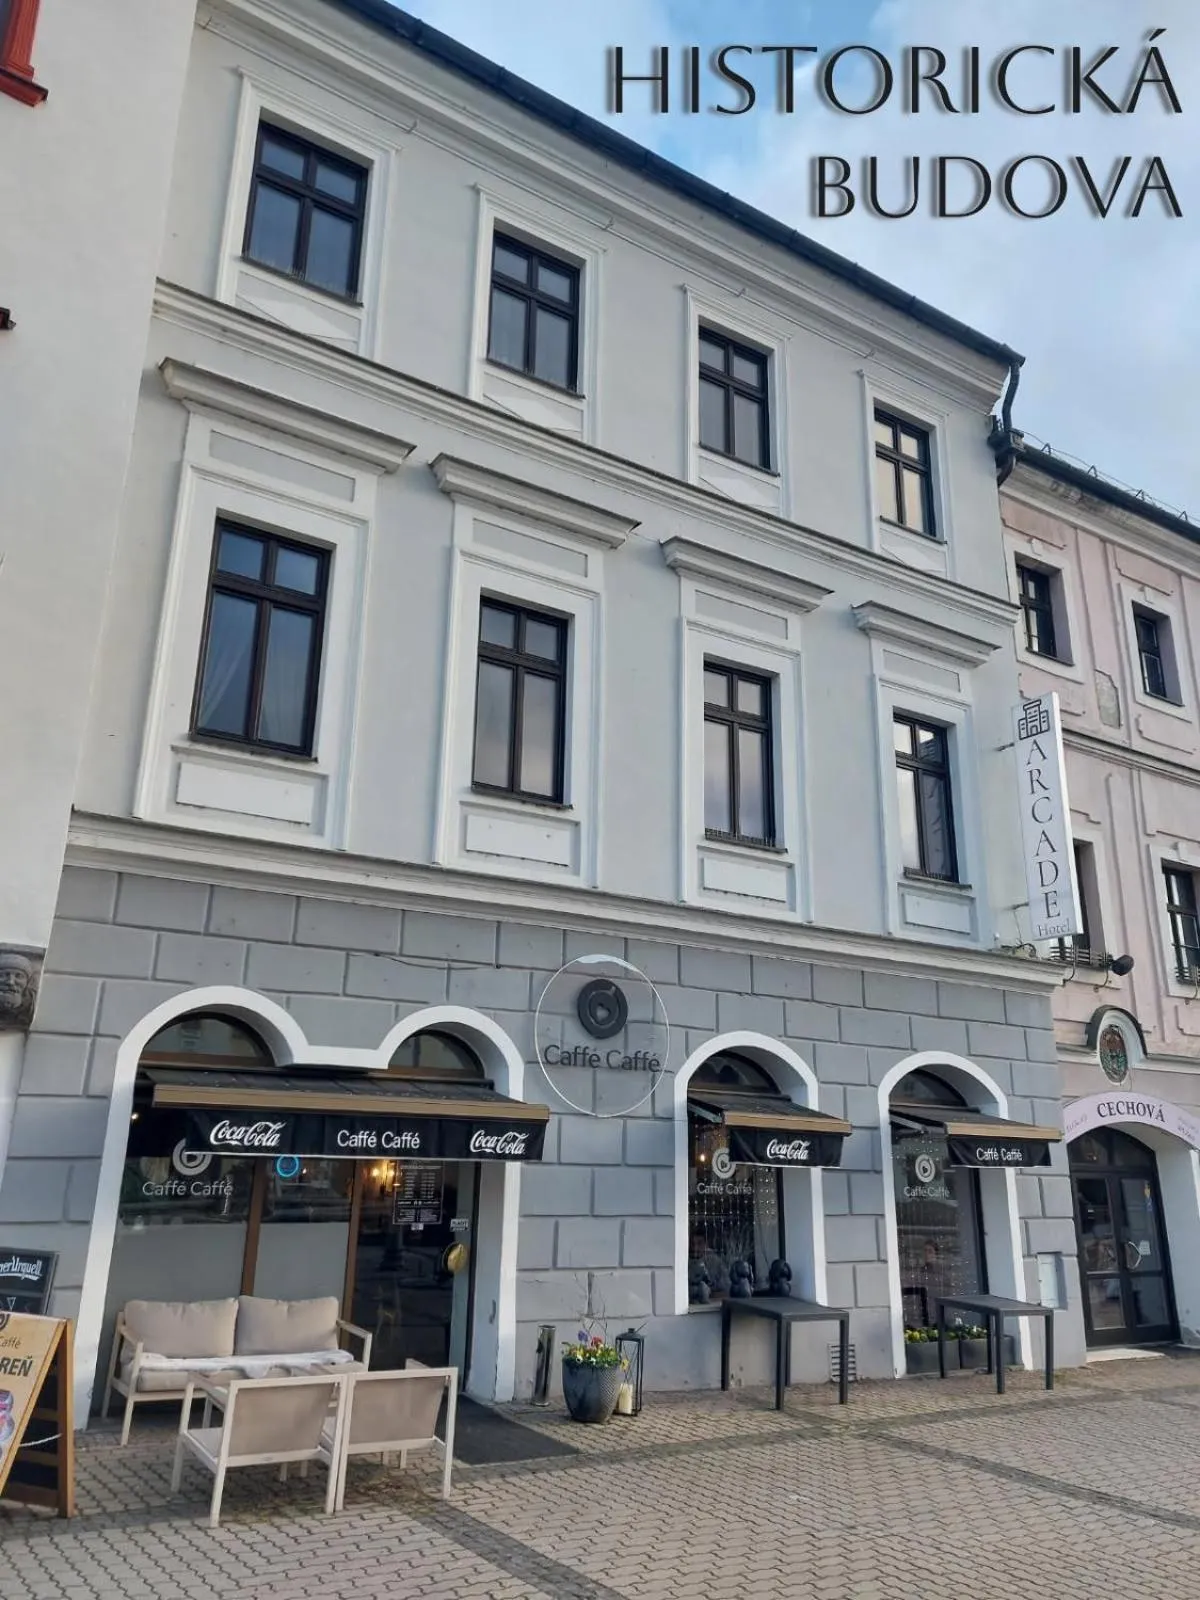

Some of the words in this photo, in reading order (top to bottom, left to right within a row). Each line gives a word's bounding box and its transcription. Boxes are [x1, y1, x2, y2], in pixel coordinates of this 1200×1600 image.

[1026, 738, 1061, 919] ARCADE
[1036, 922, 1071, 938] Hotel
[543, 1044, 601, 1069] Caffé
[606, 1050, 662, 1073] Caffé
[1097, 1101, 1166, 1123] CECHOVÁ
[337, 1129, 378, 1148] Caffé
[381, 1131, 420, 1149] Caffé
[142, 1181, 186, 1196] Caffé
